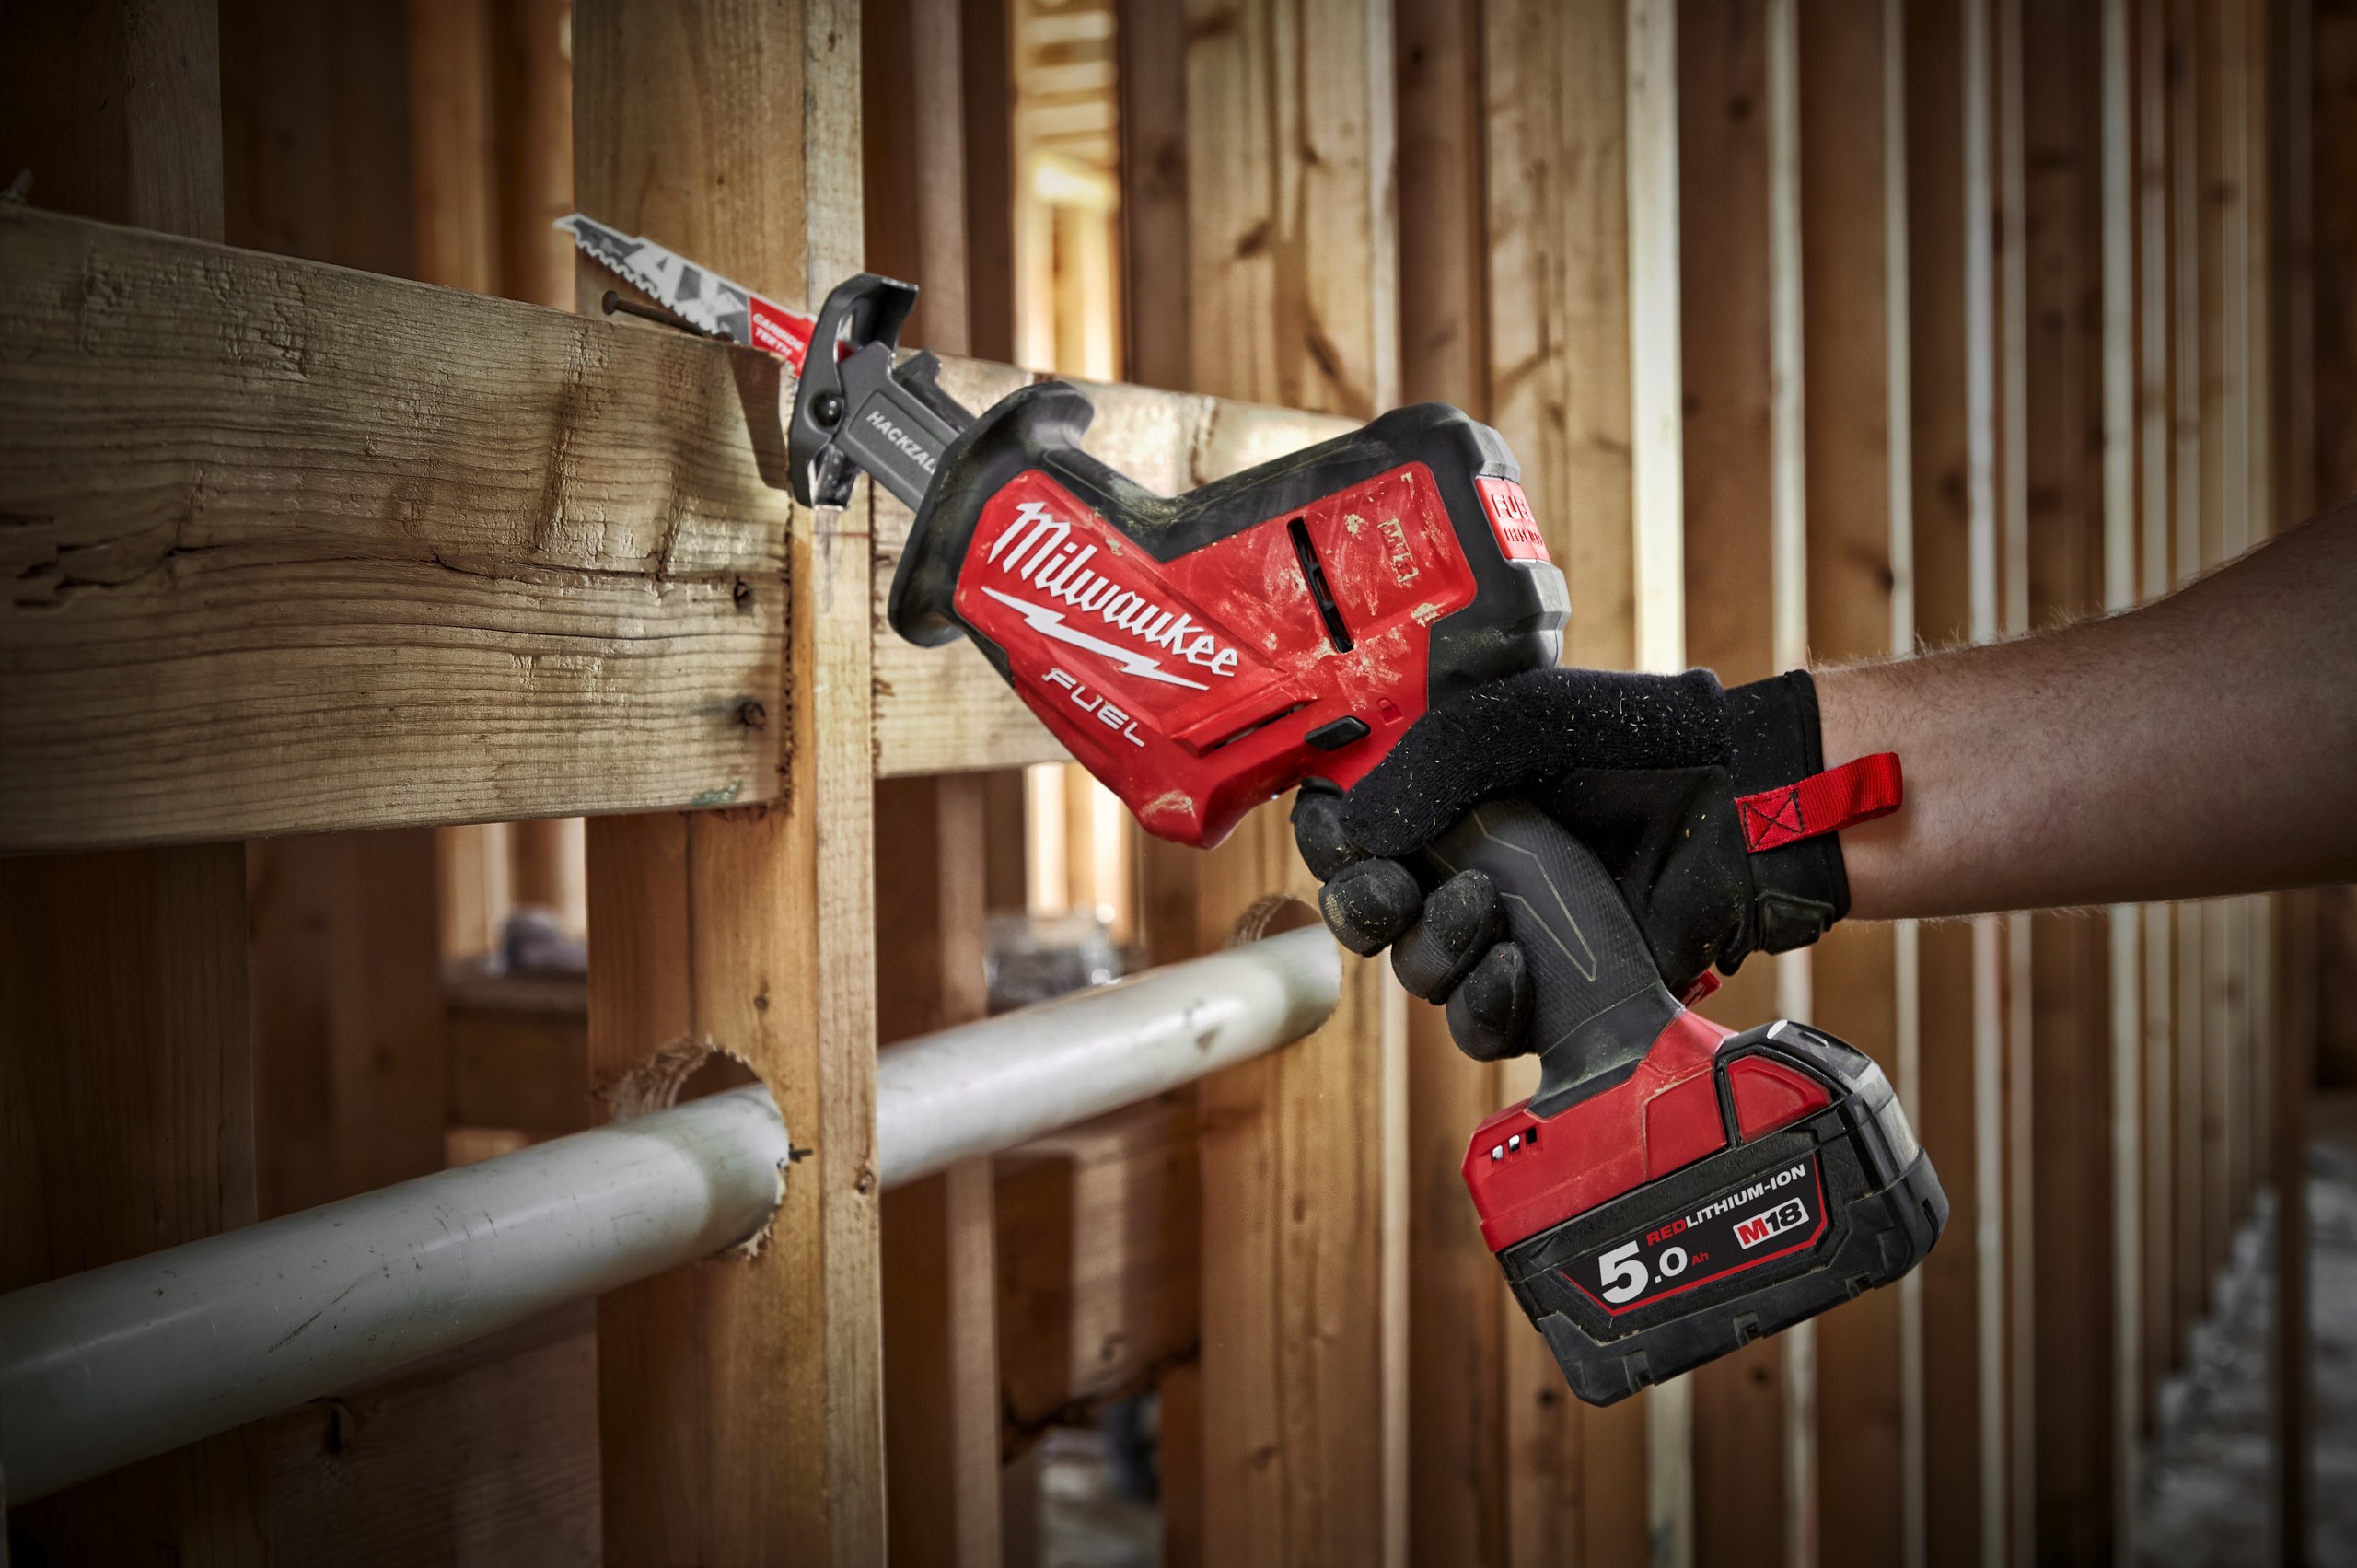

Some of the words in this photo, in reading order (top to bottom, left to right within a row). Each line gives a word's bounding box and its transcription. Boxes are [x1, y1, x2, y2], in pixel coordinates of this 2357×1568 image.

[752, 313, 805, 352] CARBIDE
[755, 327, 793, 356] TEETH
[865, 410, 937, 476] HACKZAL
[987, 501, 1238, 677] Milwaukee
[1043, 668, 1145, 748] FUEL
[1646, 1163, 1806, 1247] REDLITHIUM-ION
[1737, 1201, 1803, 1246] M18
[1598, 1240, 1688, 1304] 5.0
[1691, 1251, 1710, 1267] Ah
